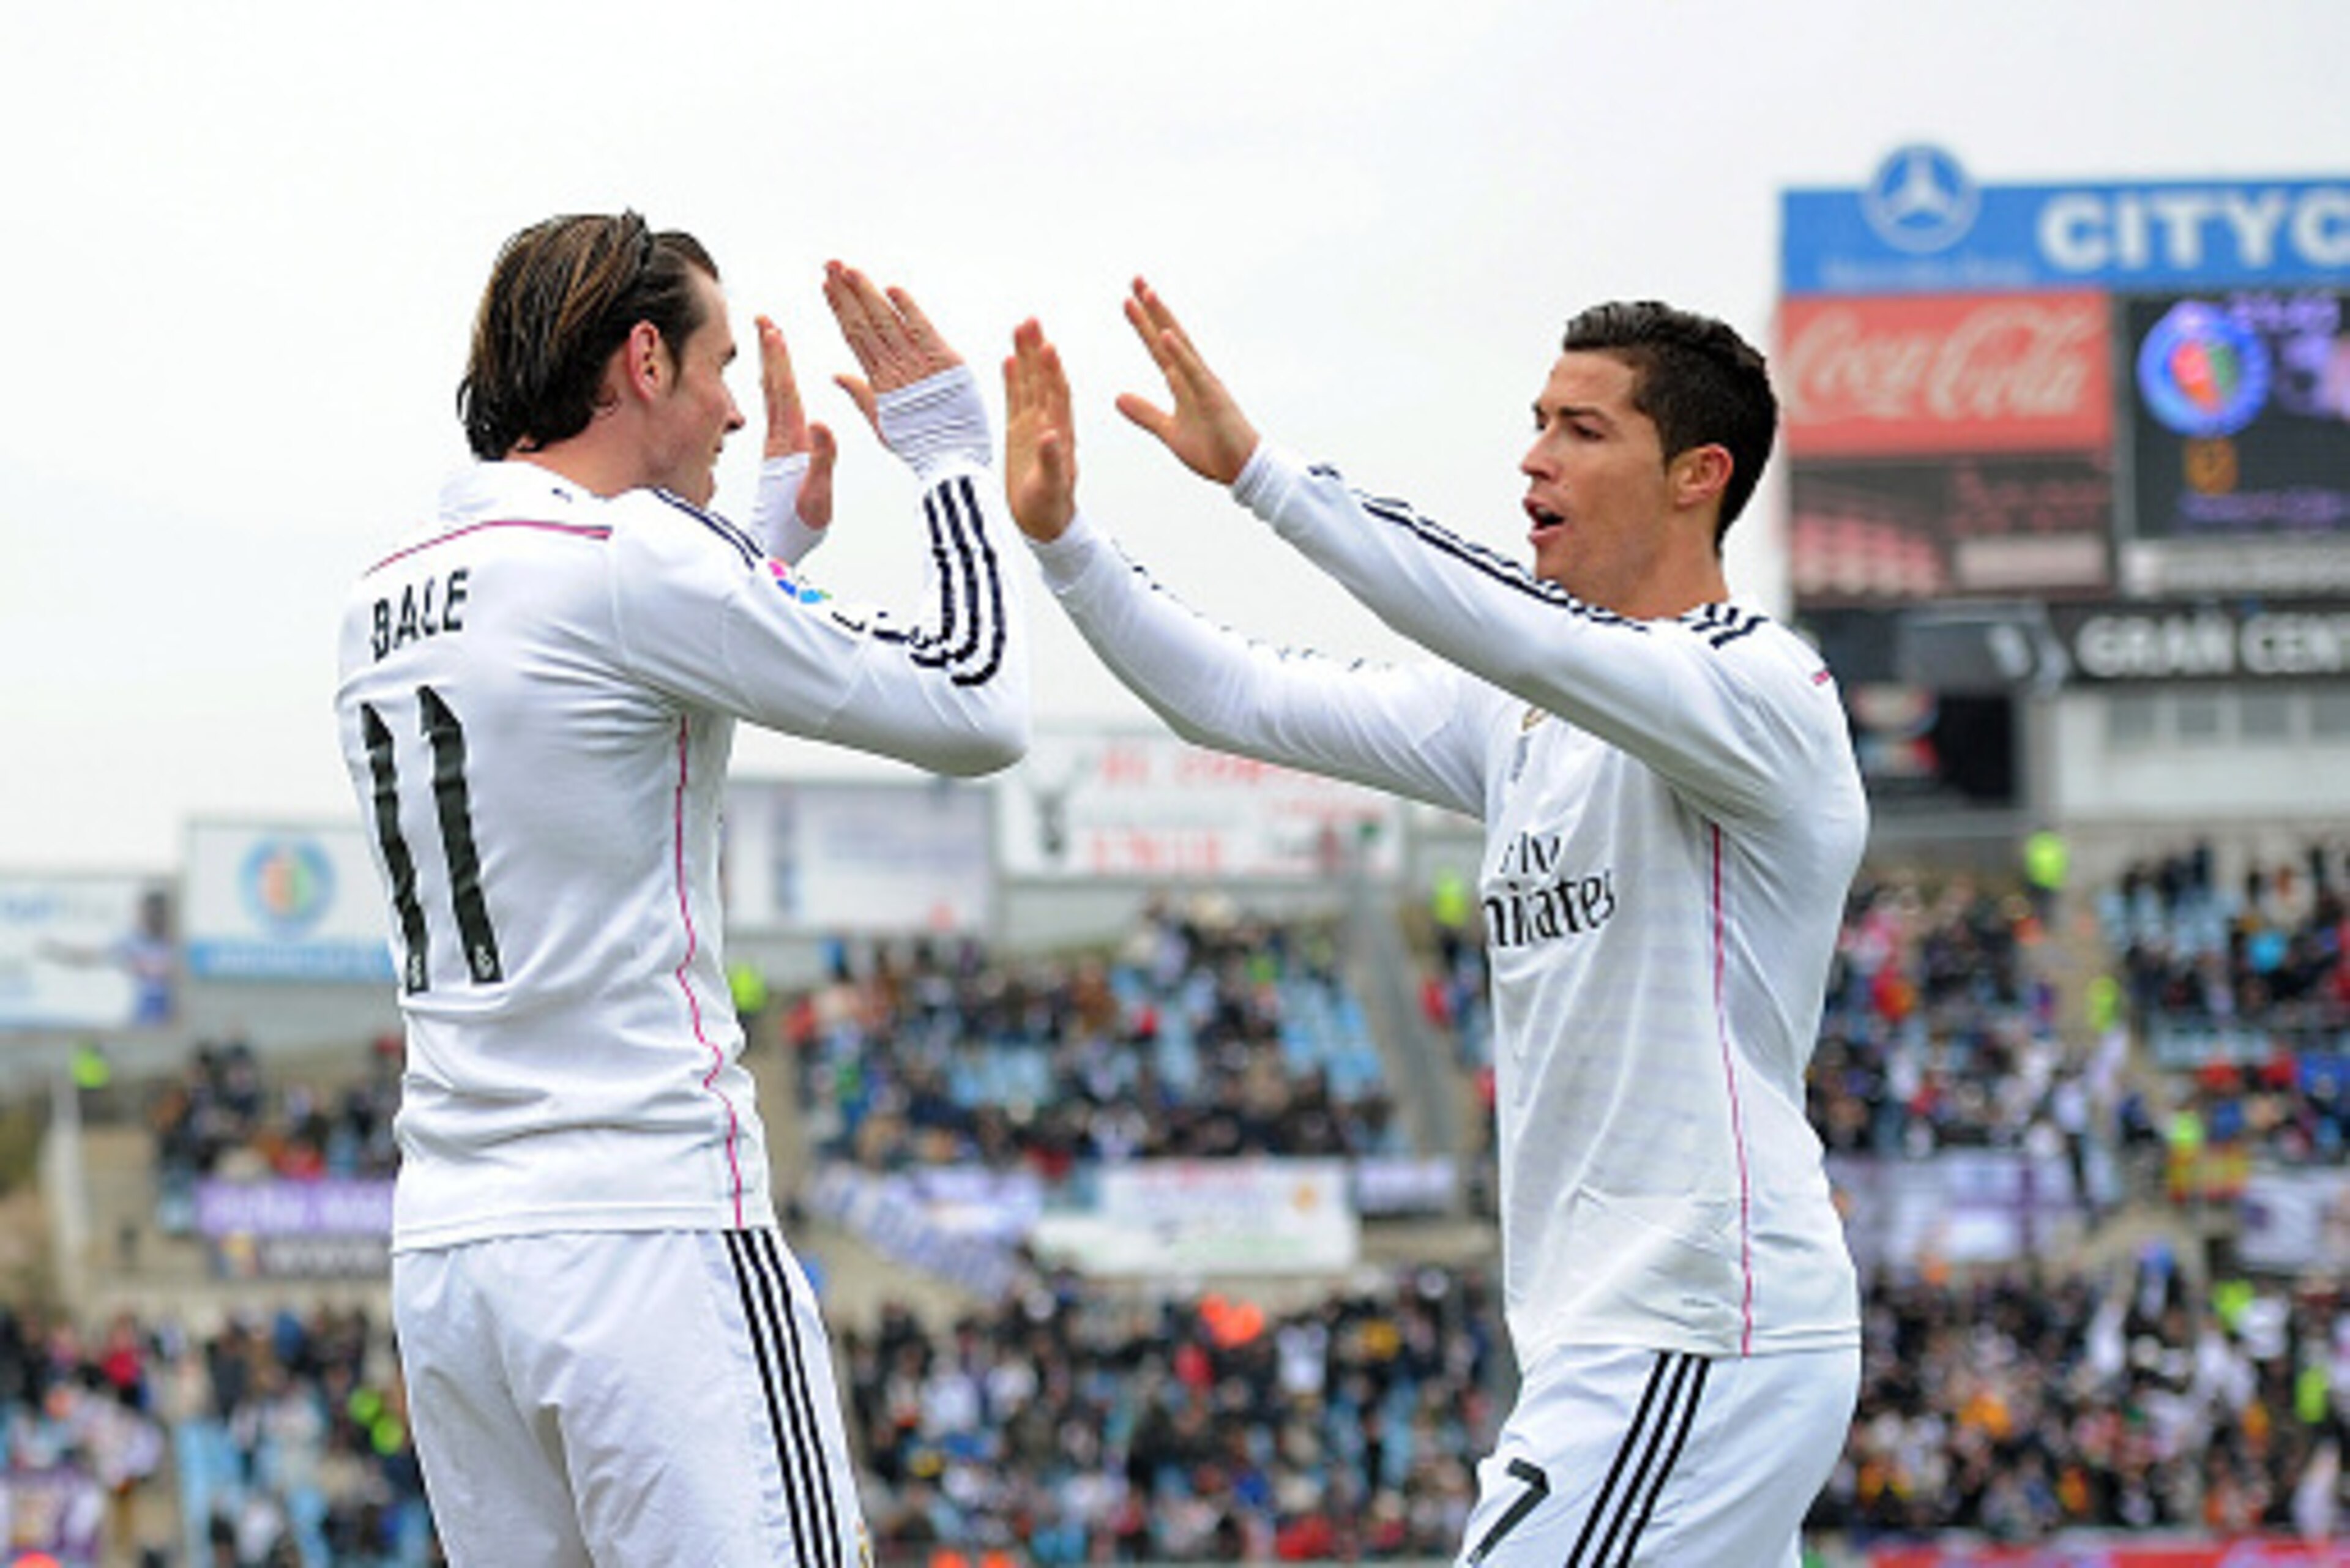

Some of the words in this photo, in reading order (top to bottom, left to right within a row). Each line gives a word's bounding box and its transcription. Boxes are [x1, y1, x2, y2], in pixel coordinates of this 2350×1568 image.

[371, 568, 470, 663] BALE
[361, 685, 504, 996] 11
[1467, 1457, 1551, 1564] 7
